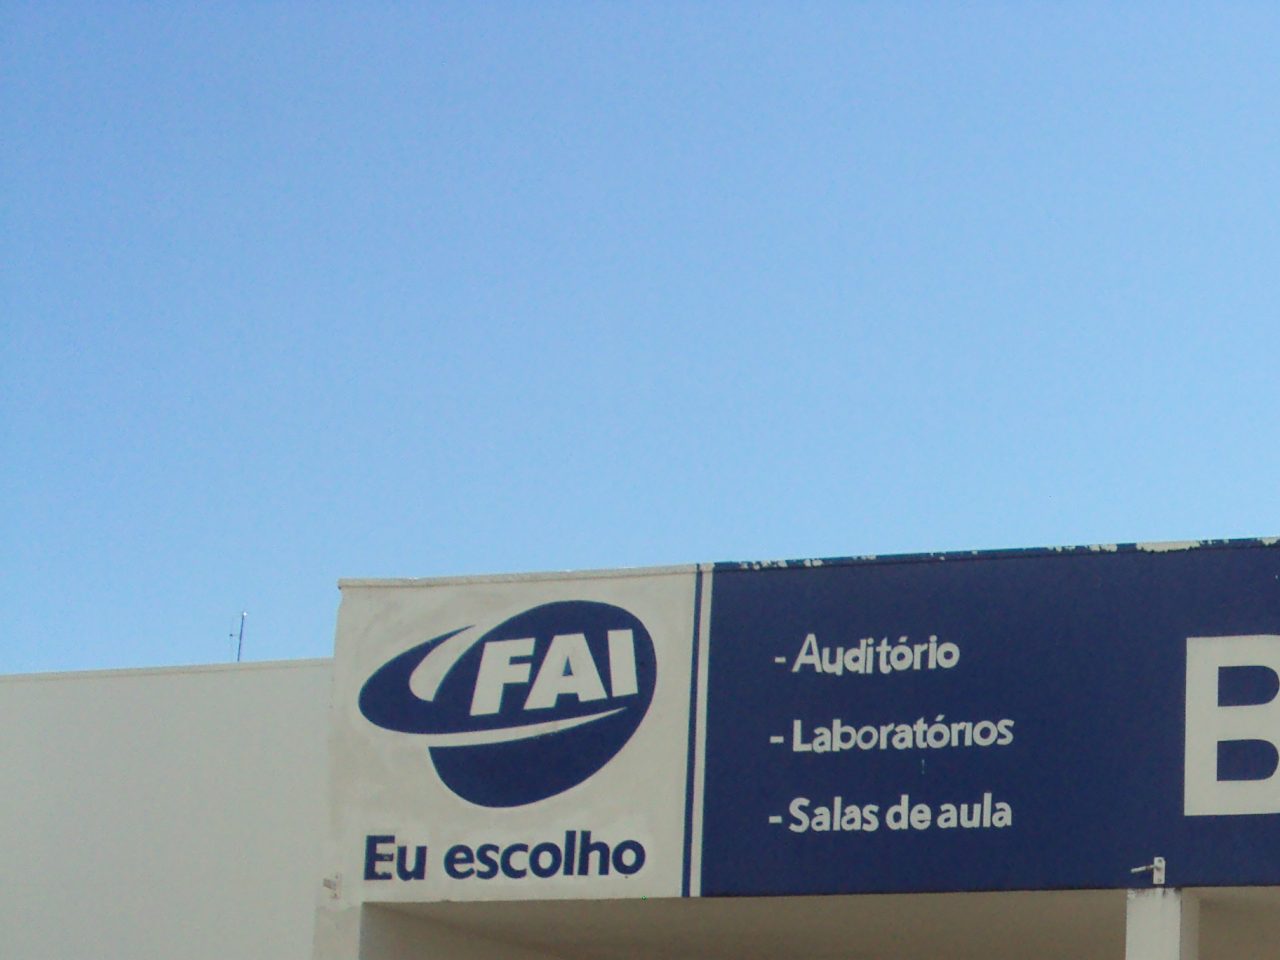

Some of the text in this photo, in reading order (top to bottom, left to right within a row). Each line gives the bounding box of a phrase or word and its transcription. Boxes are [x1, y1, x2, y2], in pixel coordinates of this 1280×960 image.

[469, 629, 639, 717] FAI
[792, 633, 961, 676] Auditório
[792, 714, 1015, 754] Laboratórios
[788, 796, 879, 833] Salas
[885, 794, 932, 831] de
[936, 792, 1012, 831] aula
[363, 829, 646, 882] Eu escolho
